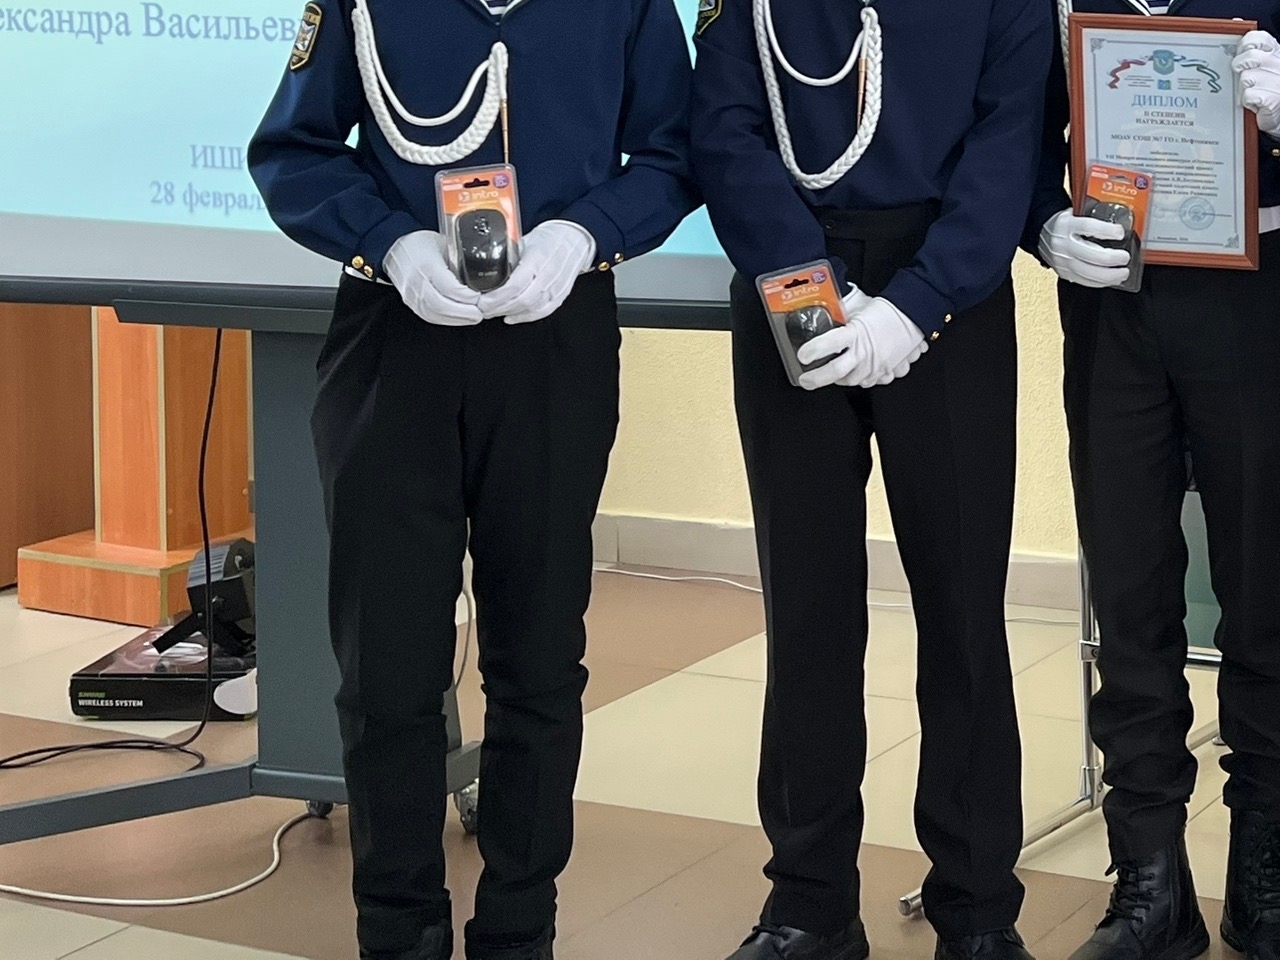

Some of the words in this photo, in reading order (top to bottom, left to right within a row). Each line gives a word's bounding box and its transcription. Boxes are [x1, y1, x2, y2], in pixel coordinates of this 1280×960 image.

[141, 1, 298, 41] Васильев
[1131, 94, 1199, 109] ДИПЛОМ
[1135, 118, 1195, 127] НАГРАЖДАЕТСЯ
[150, 180, 175, 205] 28
[182, 182, 265, 215] феврал
[78, 699, 114, 707] WIRELESS
[114, 699, 144, 708] SYSTEM
